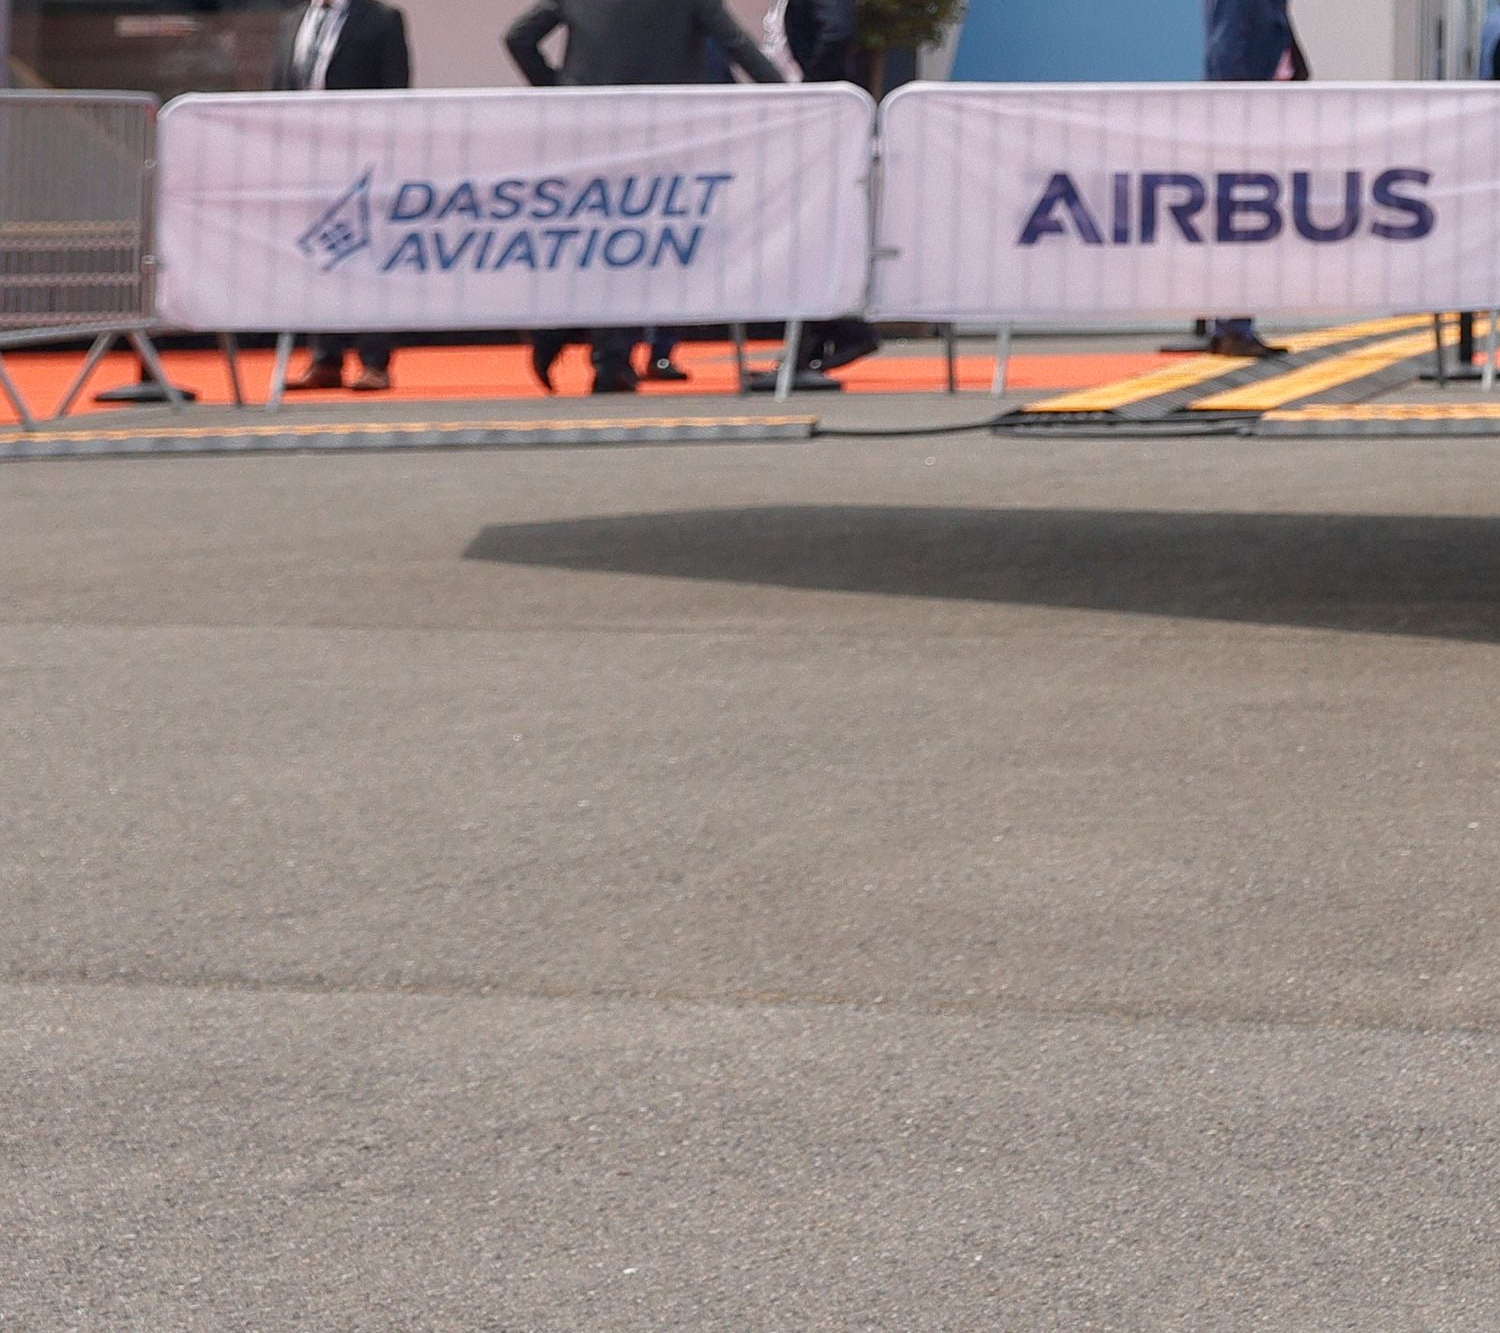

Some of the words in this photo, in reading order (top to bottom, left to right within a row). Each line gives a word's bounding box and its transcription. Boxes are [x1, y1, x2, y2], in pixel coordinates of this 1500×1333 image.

[388, 174, 735, 222] DASSAULT
[1018, 169, 1436, 245] AIRBUS
[382, 227, 705, 271] AVIATION
